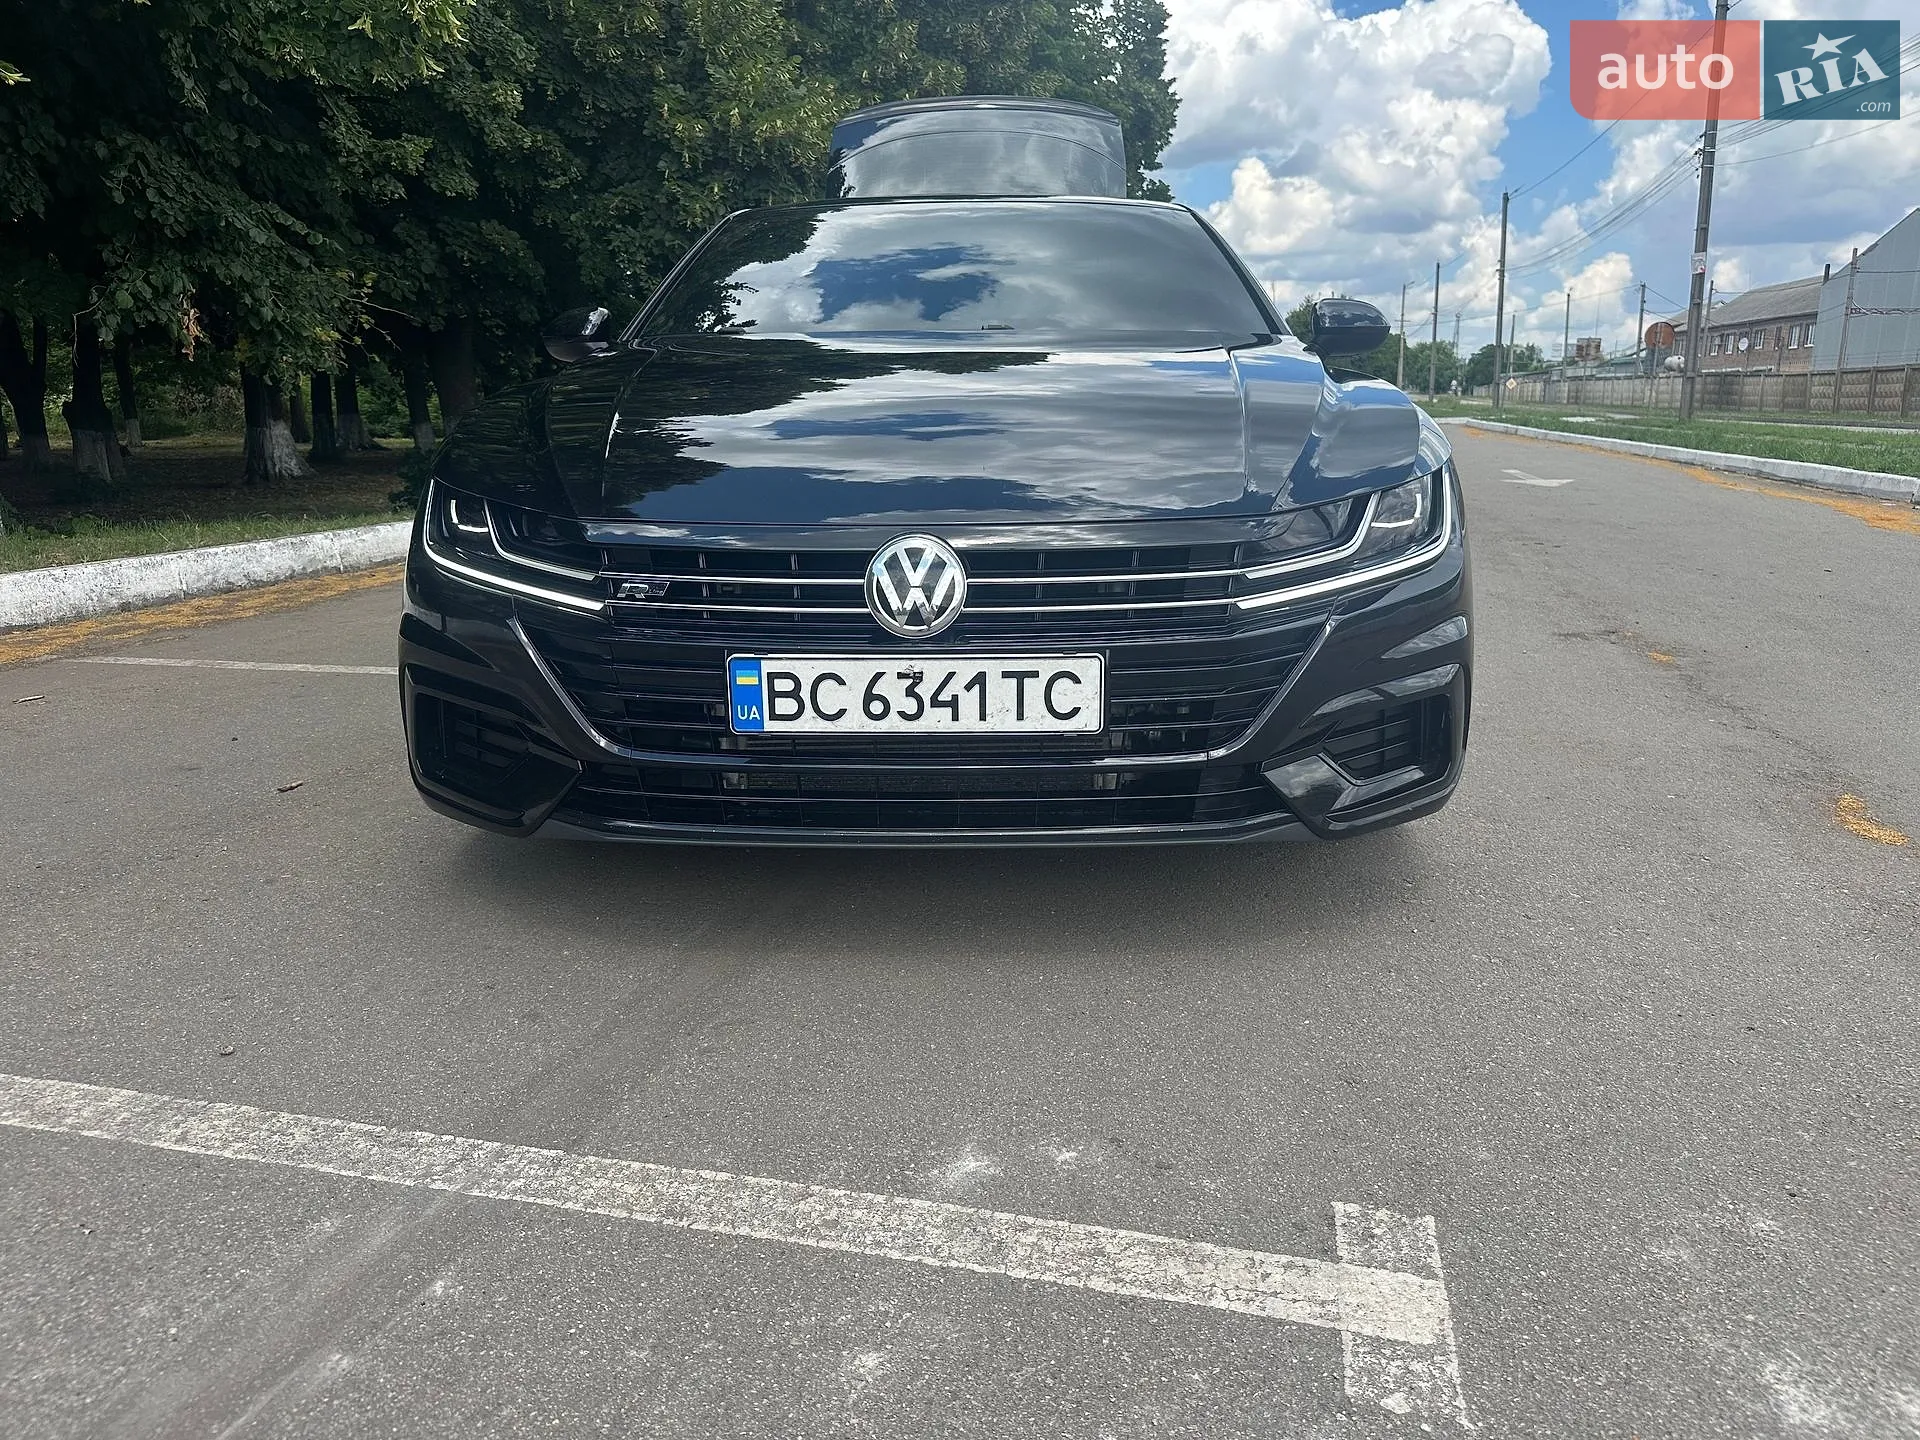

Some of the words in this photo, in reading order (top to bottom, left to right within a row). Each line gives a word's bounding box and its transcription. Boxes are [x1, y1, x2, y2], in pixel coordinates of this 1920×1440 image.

[737, 705, 760, 720] UA
[767, 671, 847, 722] BC
[863, 671, 987, 722] 6341
[1002, 670, 1082, 721] TC
